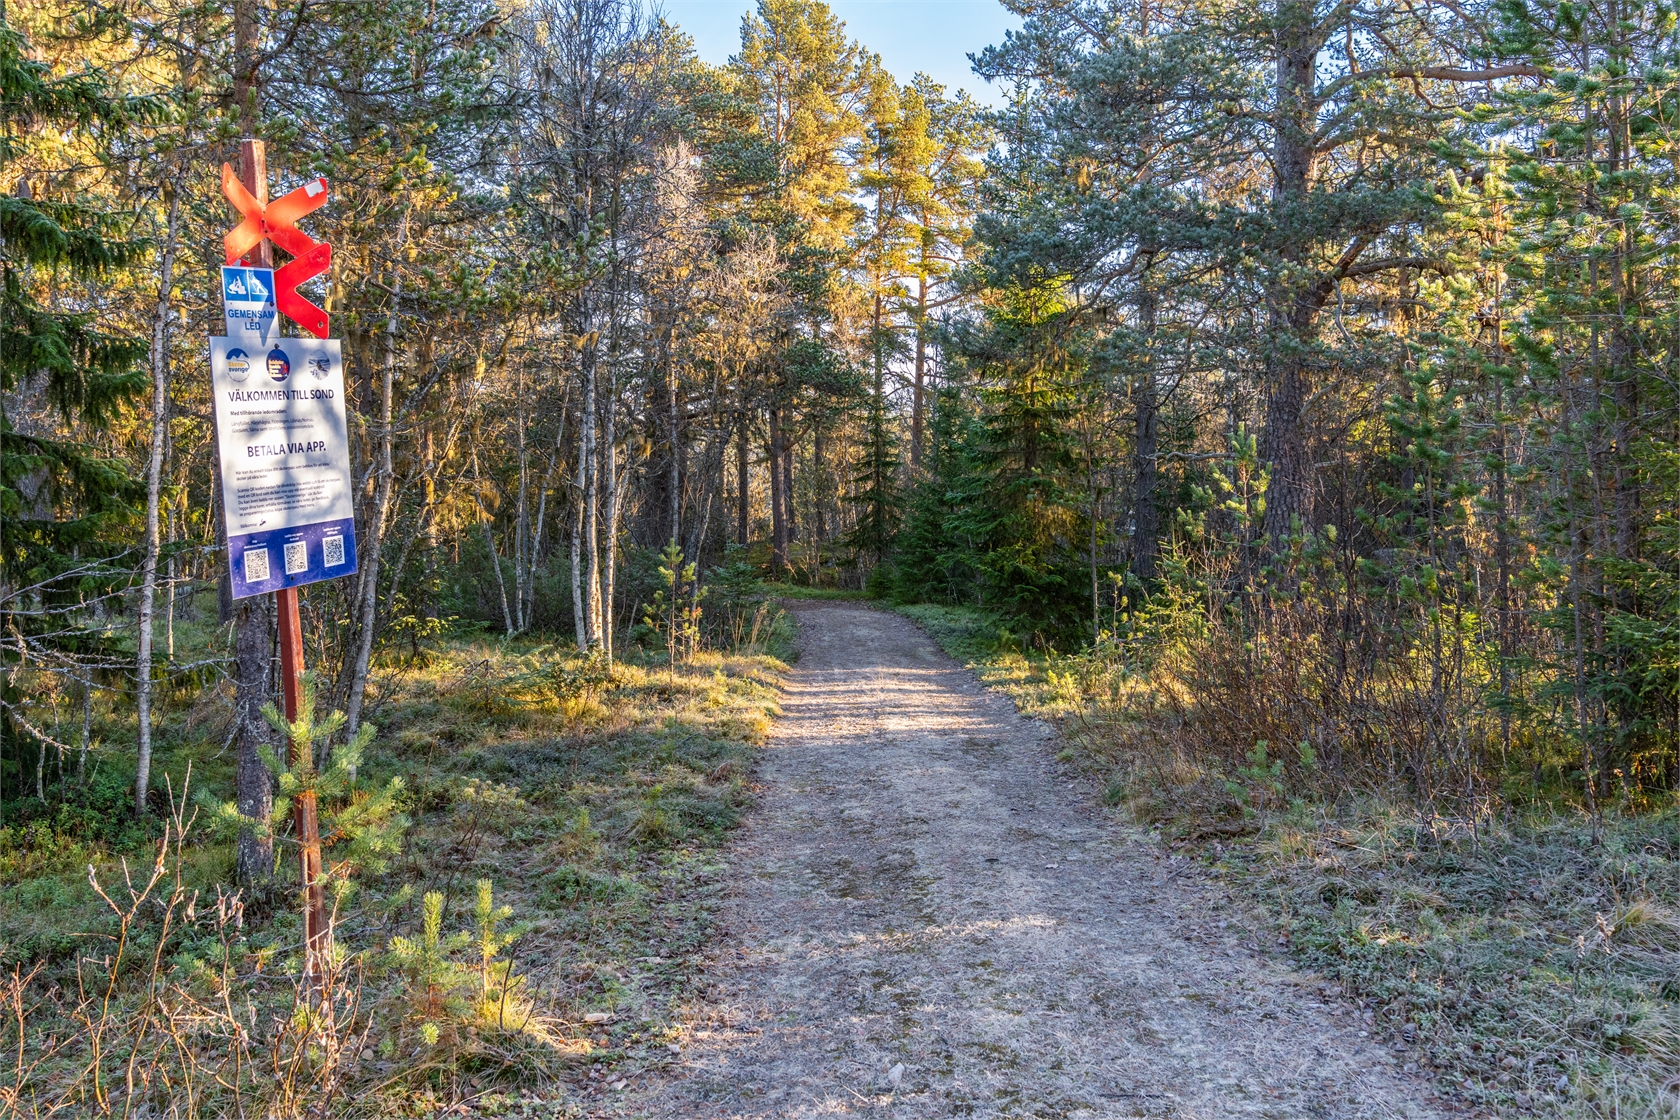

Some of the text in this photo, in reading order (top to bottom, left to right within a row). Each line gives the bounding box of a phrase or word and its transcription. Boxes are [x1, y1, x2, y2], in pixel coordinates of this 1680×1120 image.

[228, 309, 274, 319] GEMENSAM
[245, 321, 261, 330] LED
[228, 389, 334, 402] VÄLKOMMEN TILL SOND
[247, 440, 326, 457] BETALA VIA APP.
